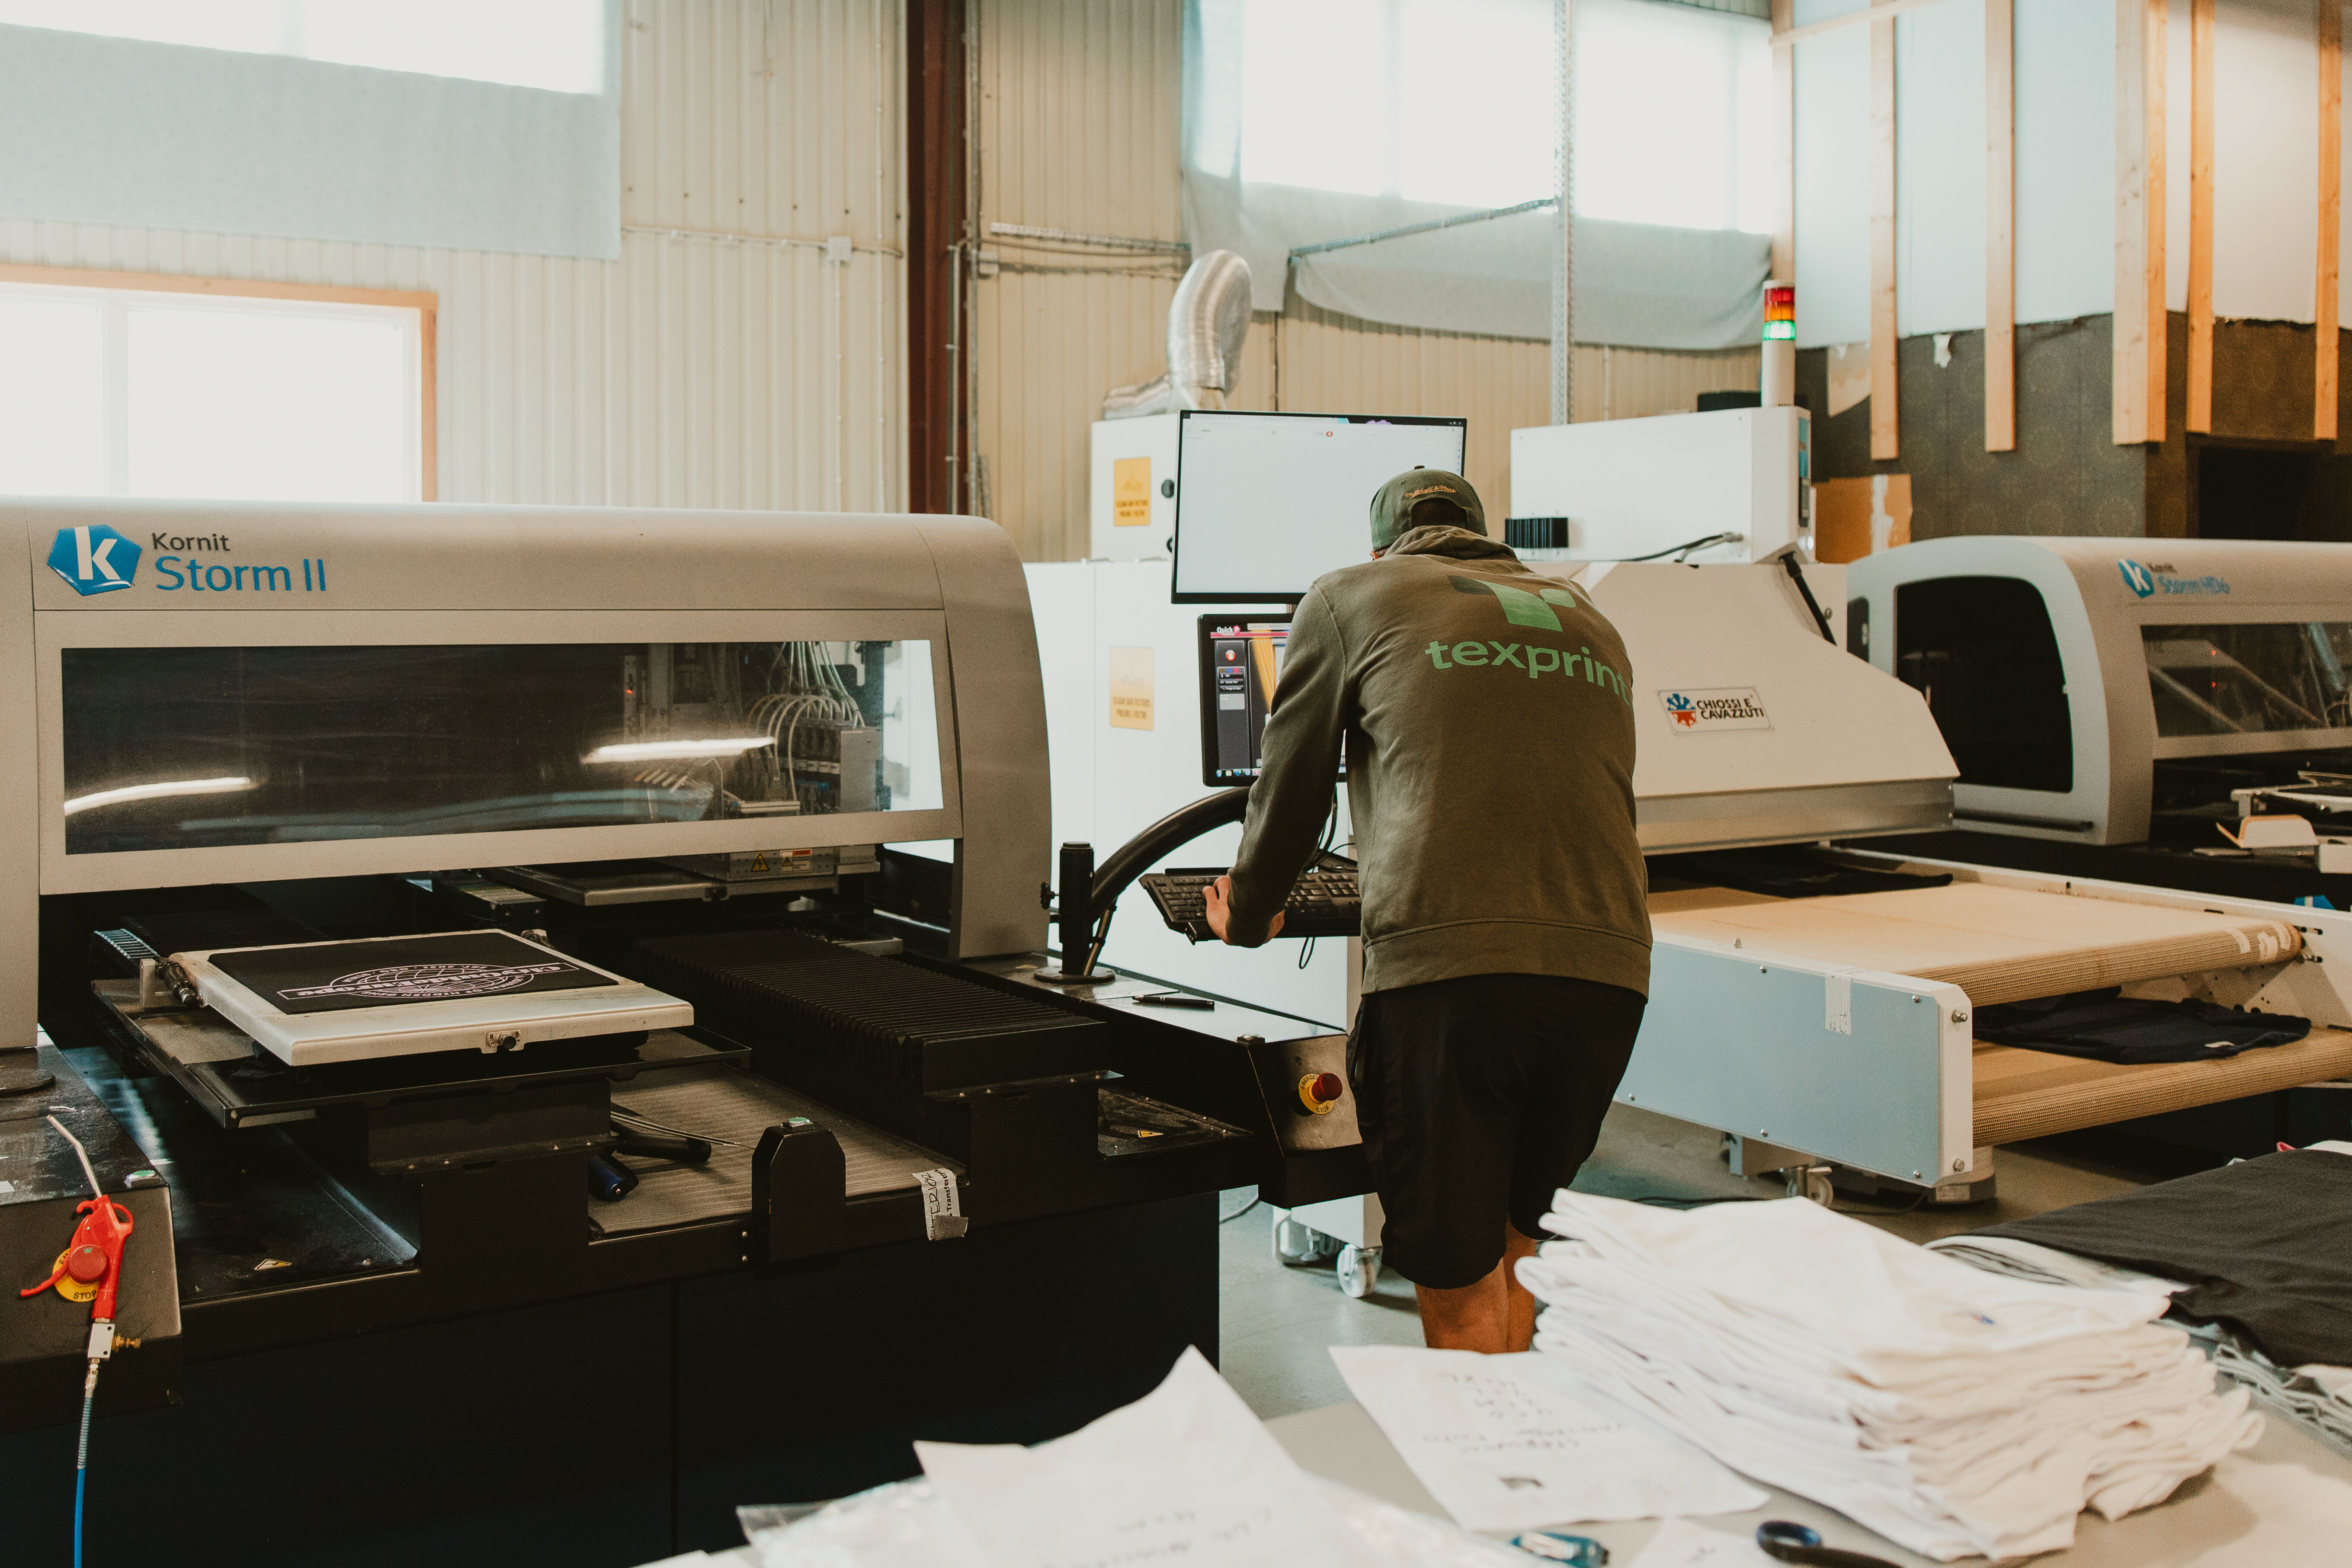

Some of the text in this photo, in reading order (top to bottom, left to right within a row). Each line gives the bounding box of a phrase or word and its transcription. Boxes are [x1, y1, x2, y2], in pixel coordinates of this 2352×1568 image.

[152, 532, 231, 552] Kornit
[155, 556, 327, 592] Storm II
[1696, 698, 1752, 710] CHIOSSI E
[1700, 708, 1765, 720] CAVAZZUTI
[296, 966, 561, 996] CityGuideEurope
[1300, 1074, 1319, 1089] EMERGE
[921, 1172, 940, 1228] TERIÖR
[74, 1290, 97, 1299] STOP
